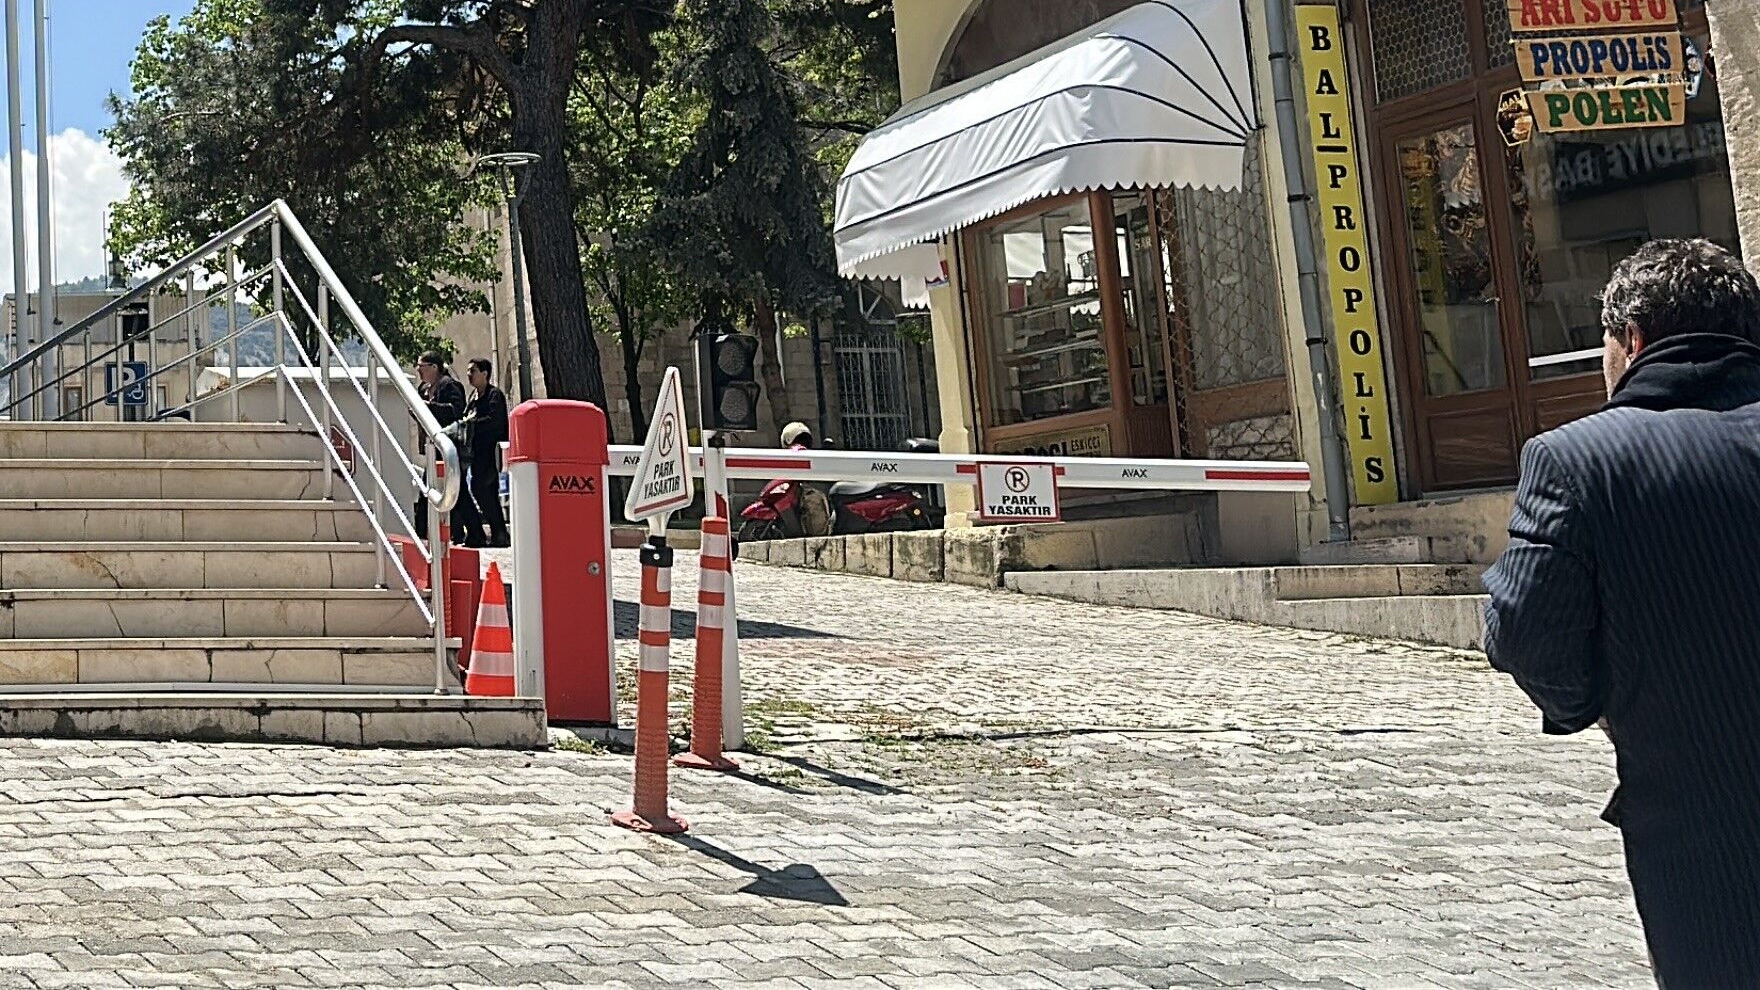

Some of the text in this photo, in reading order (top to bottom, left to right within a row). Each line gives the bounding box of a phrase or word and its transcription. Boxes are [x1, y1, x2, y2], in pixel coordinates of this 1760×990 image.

[1530, 36, 1672, 76] PROPOLİS
[1544, 87, 1672, 127] POLEN
[623, 456, 641, 465] AVA
[653, 460, 675, 480] PARK
[871, 462, 898, 473] AVAX
[1121, 468, 1148, 478] AVAX
[549, 475, 595, 491] AVAX
[644, 475, 680, 500] YASAKTIR
[1002, 495, 1037, 505] PARK
[989, 505, 1051, 516] YASAKTIR
